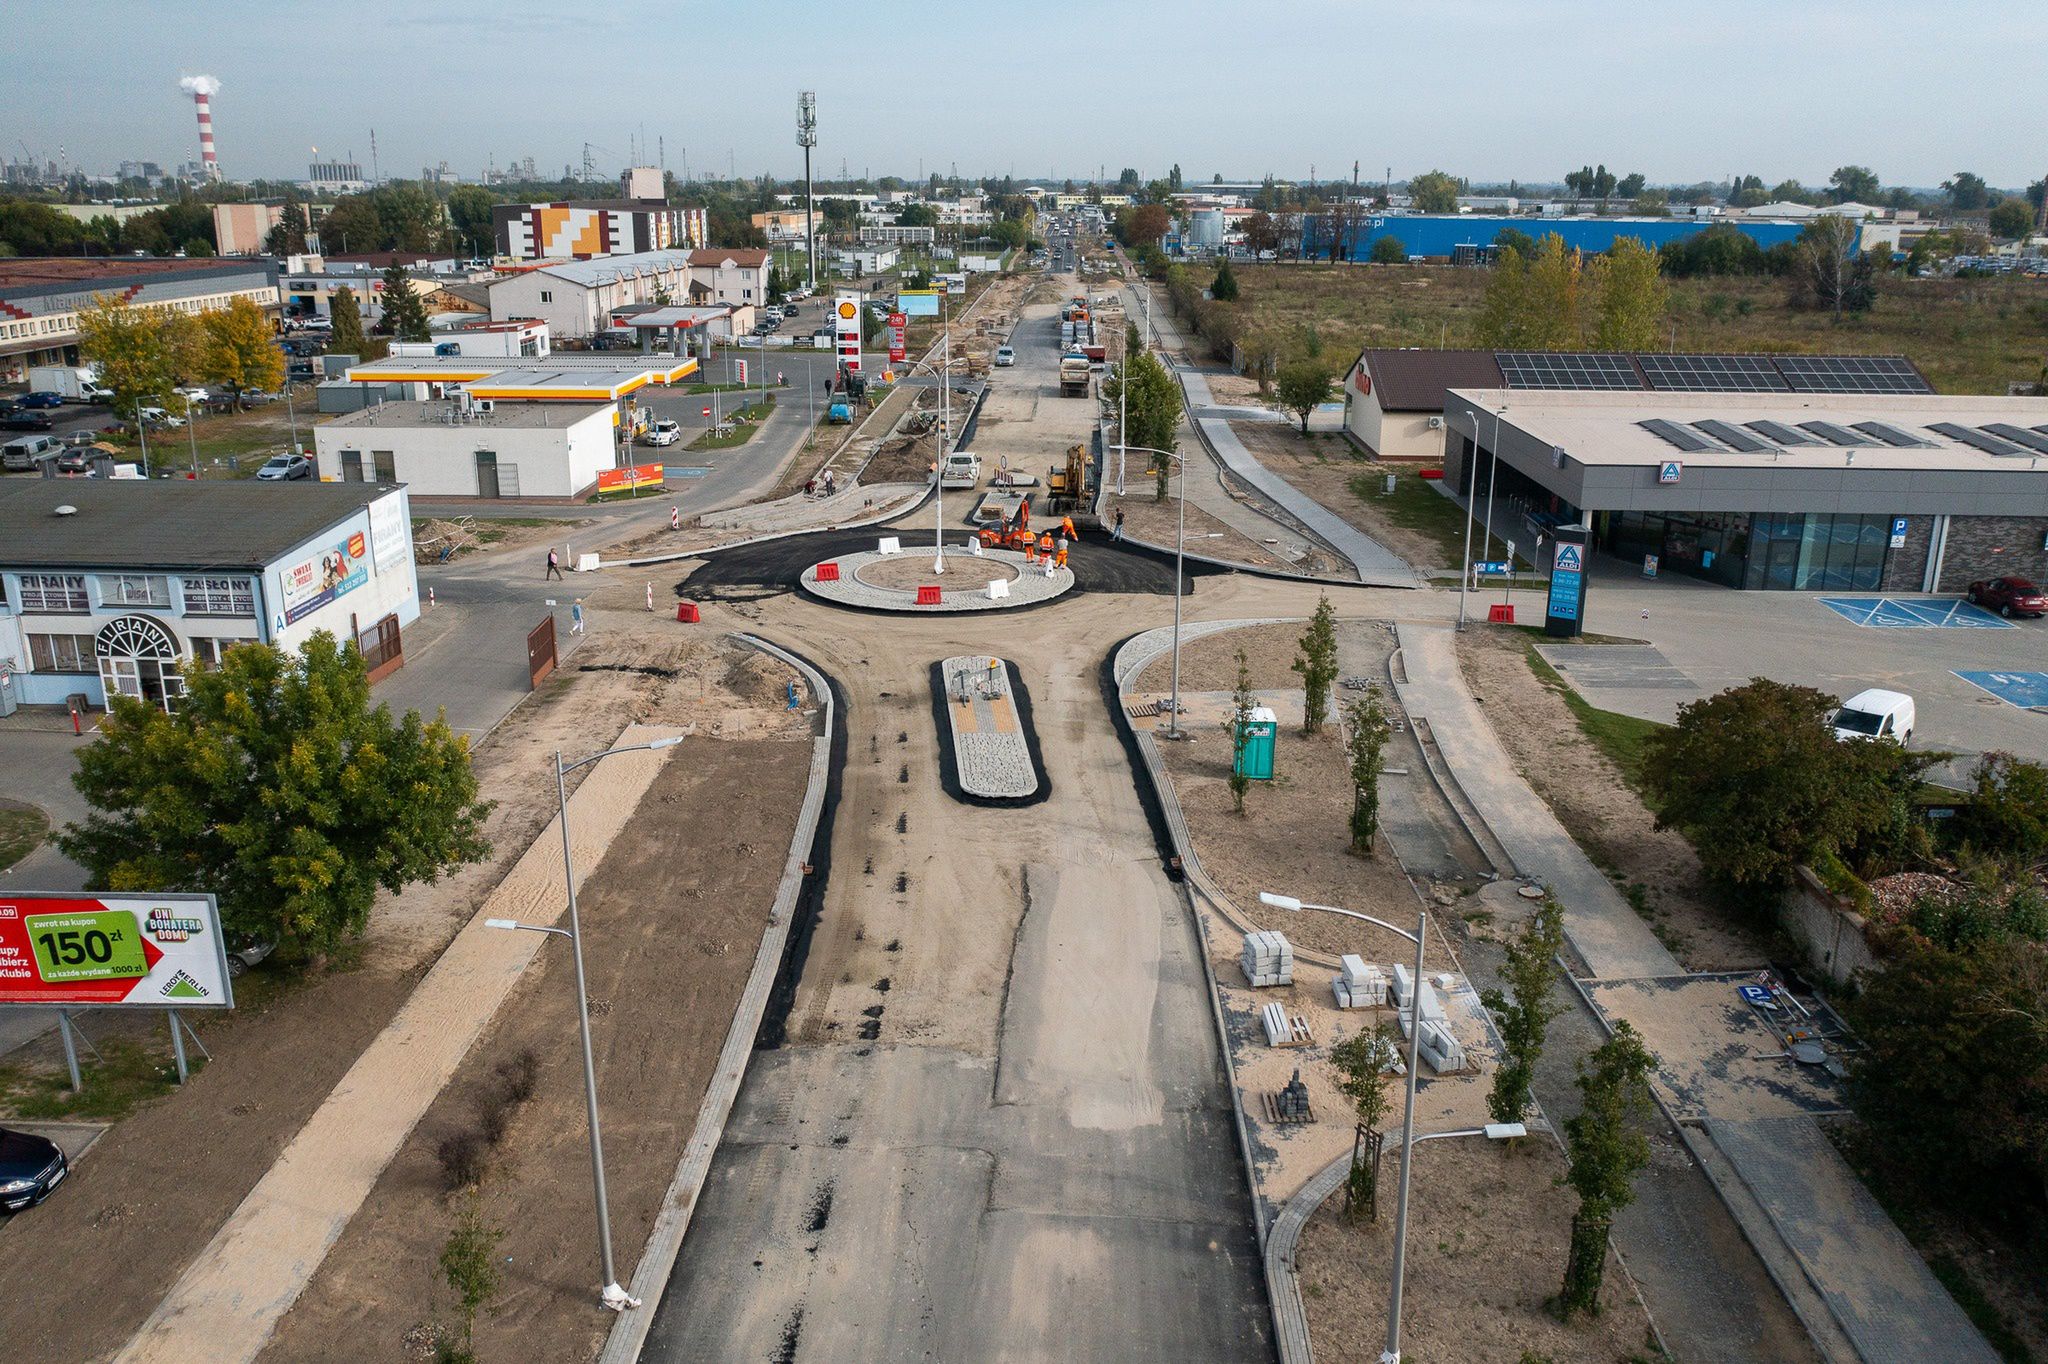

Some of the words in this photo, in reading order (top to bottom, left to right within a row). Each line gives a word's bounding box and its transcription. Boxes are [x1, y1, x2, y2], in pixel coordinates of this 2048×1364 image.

[1896, 521, 1905, 531] P
[1560, 562, 1577, 570] ALDI
[20, 575, 84, 588] FIRANY
[184, 580, 250, 590] ZASŁONY
[98, 621, 170, 653] FIRANY
[154, 909, 173, 919] DNI
[33, 920, 58, 928] zwrot
[71, 918, 97, 927] kupon
[149, 919, 203, 930] BOHATERA
[158, 930, 189, 940] DOMU
[39, 929, 112, 966] 150
[109, 929, 123, 941] zł
[0, 957, 29, 967] bierz
[0, 968, 32, 978] Klubie
[81, 968, 111, 977] wydane
[111, 965, 133, 974] 1000
[134, 964, 143, 972] zł
[159, 974, 180, 996] LEROY
[176, 969, 210, 997] MERLIN
